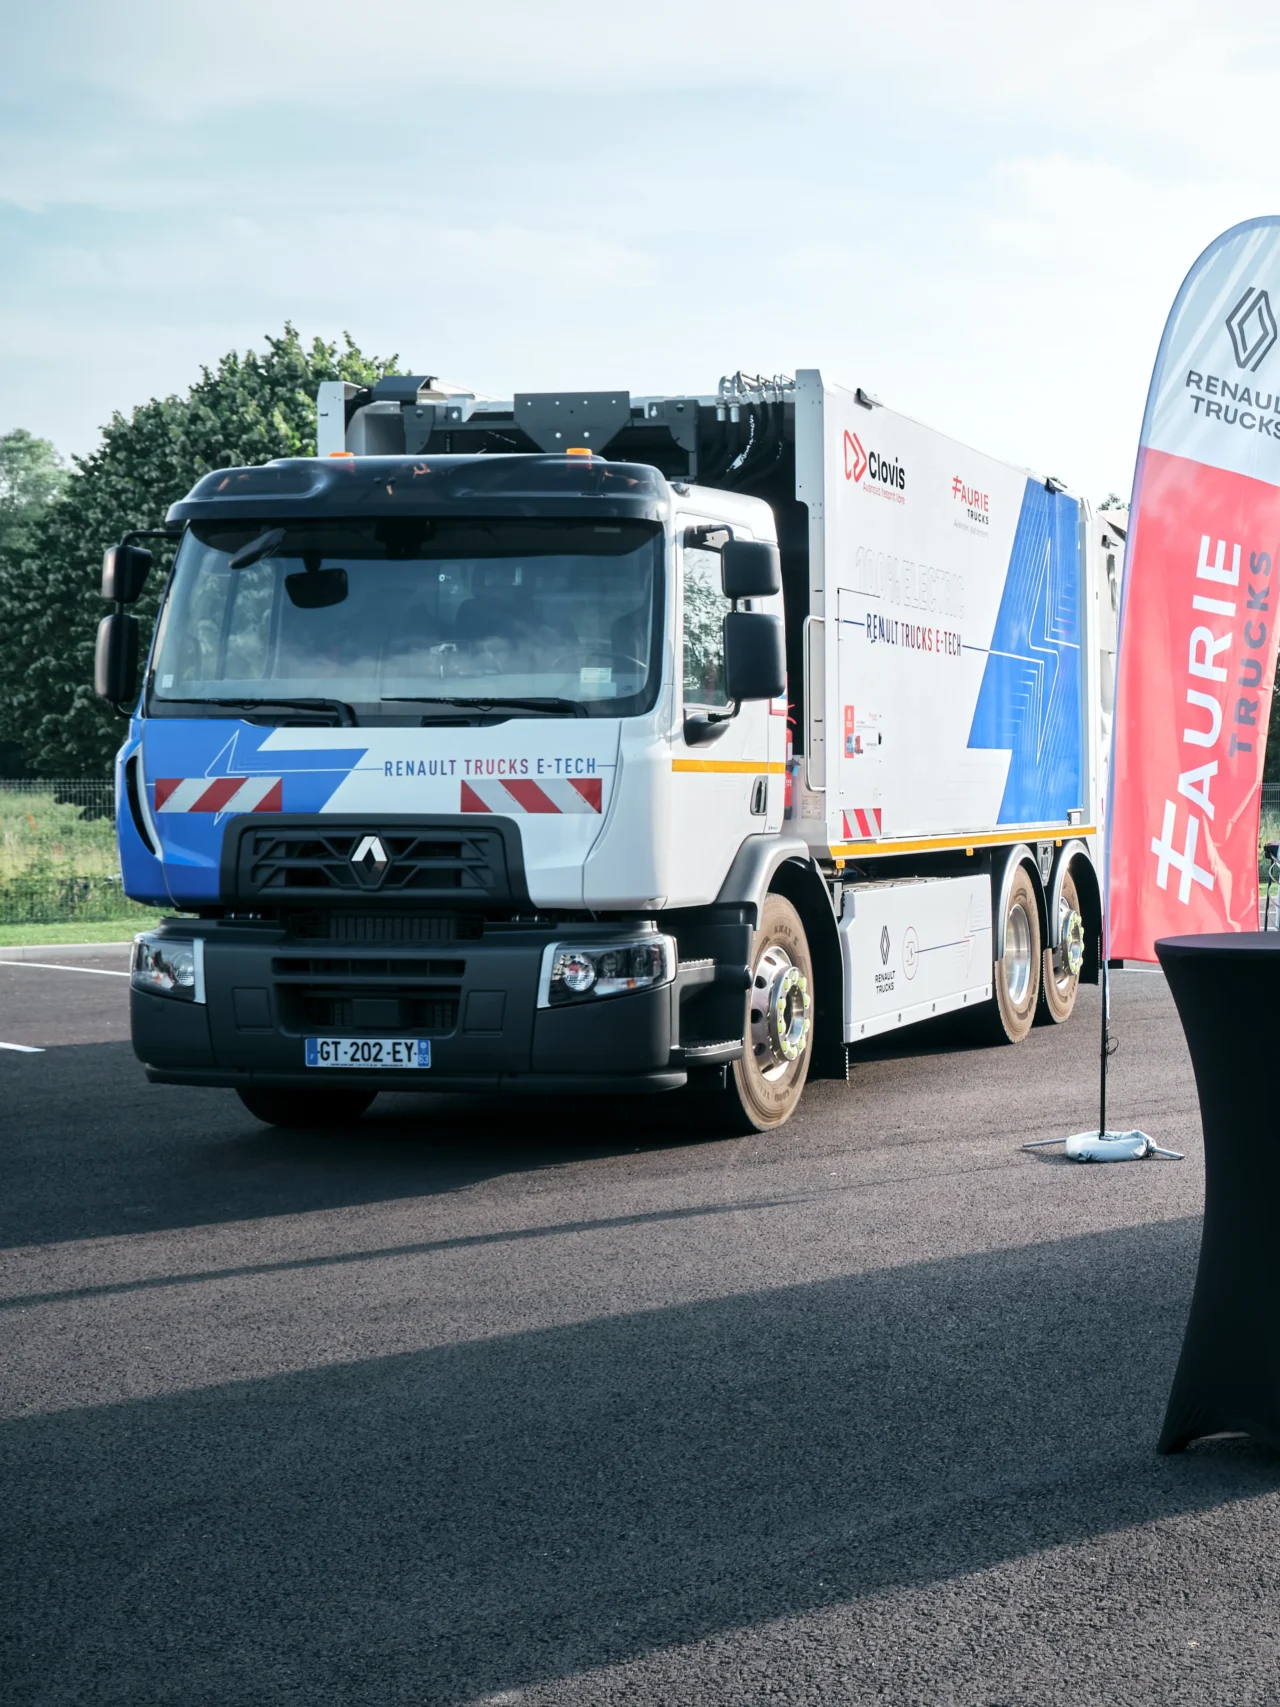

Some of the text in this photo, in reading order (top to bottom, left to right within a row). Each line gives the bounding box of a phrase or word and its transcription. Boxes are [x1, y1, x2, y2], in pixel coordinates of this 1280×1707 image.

[868, 451, 905, 490] Clovis
[967, 508, 989, 525] TRUCKS
[902, 559, 965, 620] ELECTRIC
[901, 622, 933, 652] TRUCKS
[935, 629, 962, 657] E-TECH
[1228, 551, 1272, 759] TRUCKS
[384, 757, 596, 777] RENAULT TRUCKS E-TECH
[875, 970, 896, 984] RENAULT
[876, 982, 895, 995] TRUCKS
[418, 1054, 429, 1064] 63
